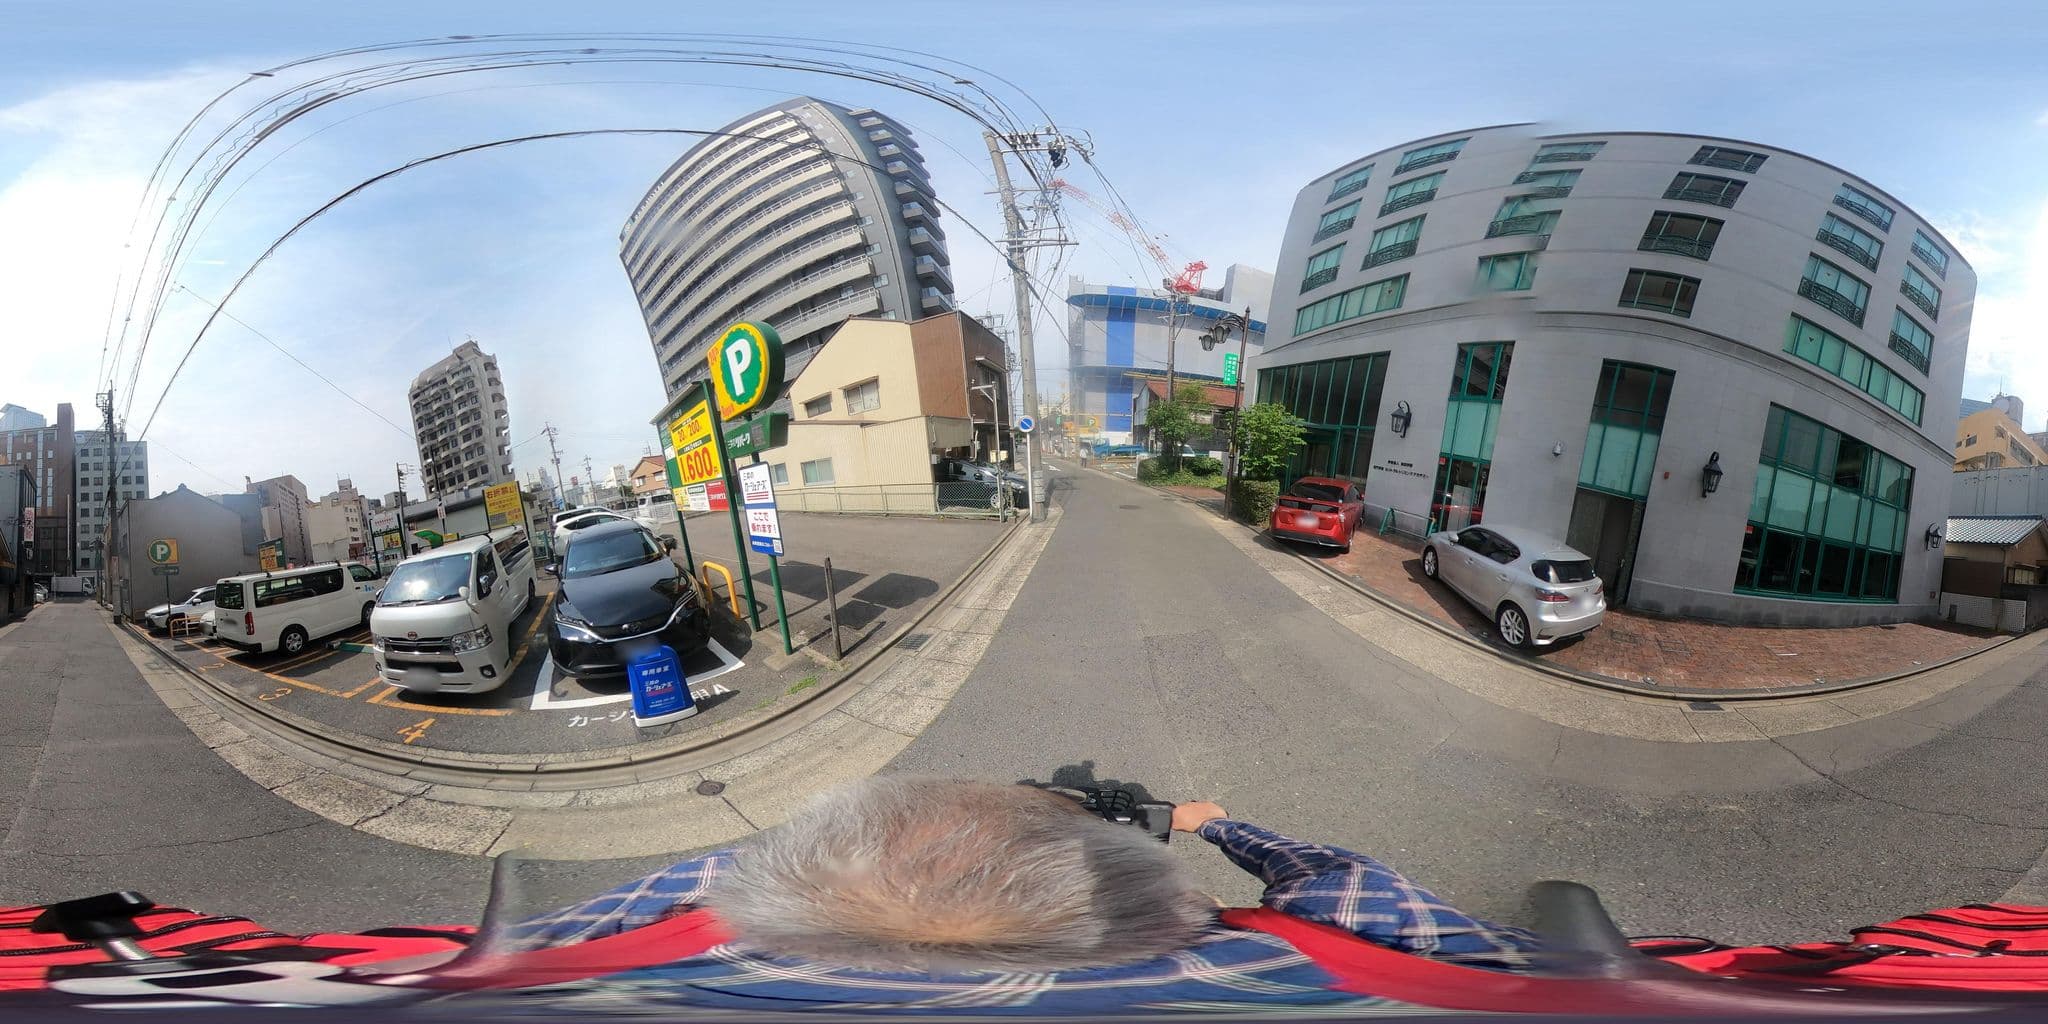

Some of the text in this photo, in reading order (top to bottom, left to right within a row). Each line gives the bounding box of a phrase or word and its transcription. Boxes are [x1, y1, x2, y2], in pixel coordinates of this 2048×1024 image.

[726, 338, 752, 397] P
[156, 544, 168, 560] P
[396, 717, 436, 745] 4
